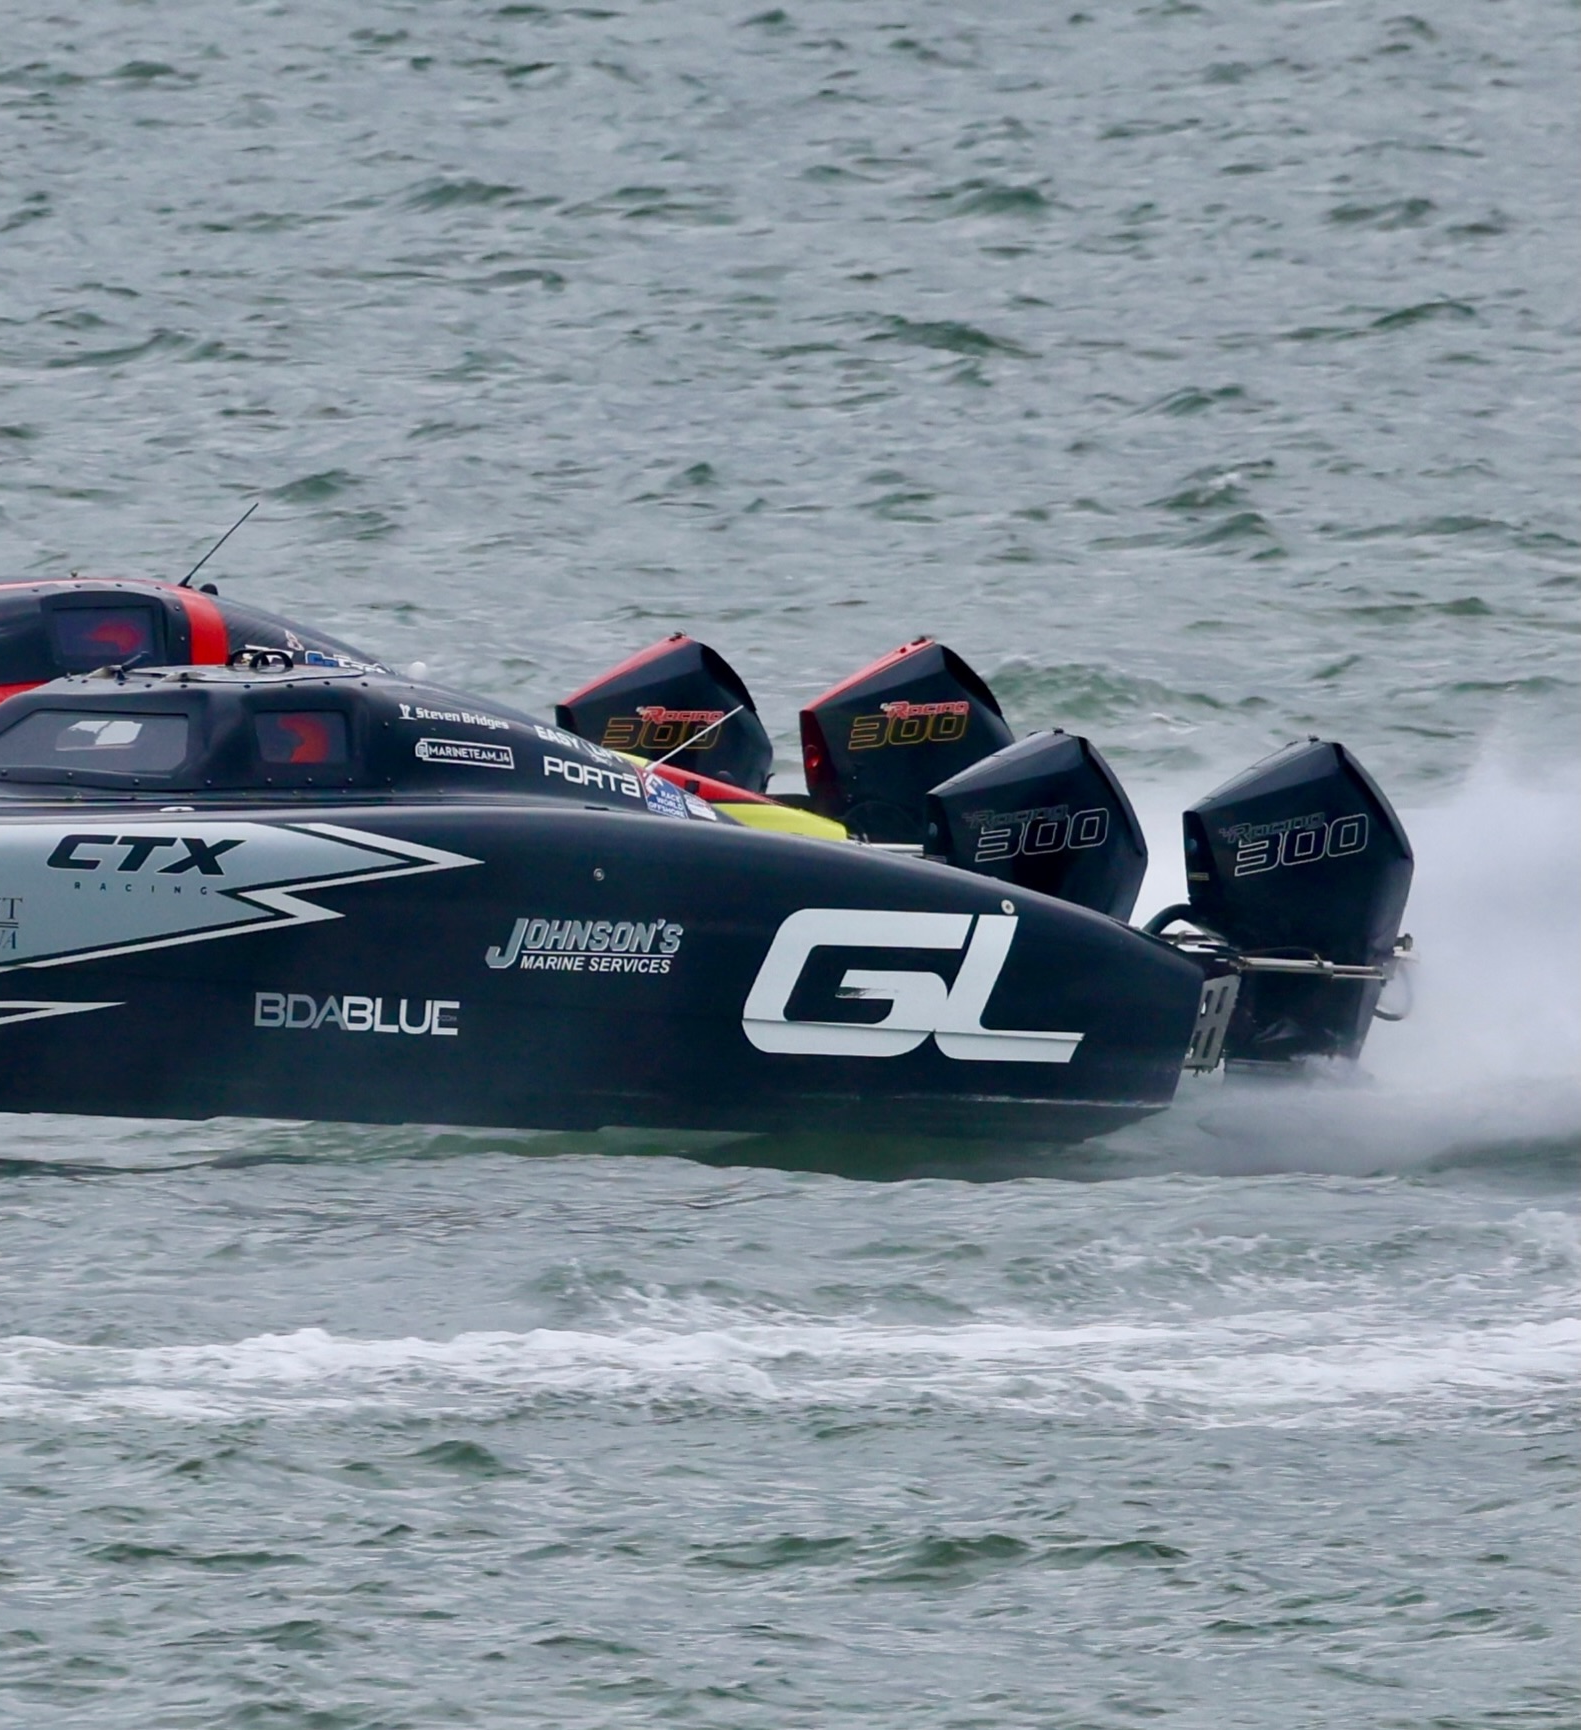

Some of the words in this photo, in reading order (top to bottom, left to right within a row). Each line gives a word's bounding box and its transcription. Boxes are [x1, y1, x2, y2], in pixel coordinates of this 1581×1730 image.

[415, 707, 460, 722] Steven
[461, 712, 509, 730] Bridges
[891, 701, 969, 719] Racing
[533, 724, 580, 749] EASY
[600, 717, 721, 750] 300
[848, 713, 967, 750] 300
[648, 801, 686, 818] OFFSHORE
[656, 796, 685, 811] WORLD
[974, 807, 1109, 862] 300
[1234, 813, 1368, 877] 300
[46, 834, 247, 876] CTX
[74, 881, 208, 895] RACING
[485, 917, 684, 969] JOHNSON'S
[520, 955, 585, 971] MARINE
[588, 957, 672, 974] SERVICES
[742, 907, 1086, 1063] GL
